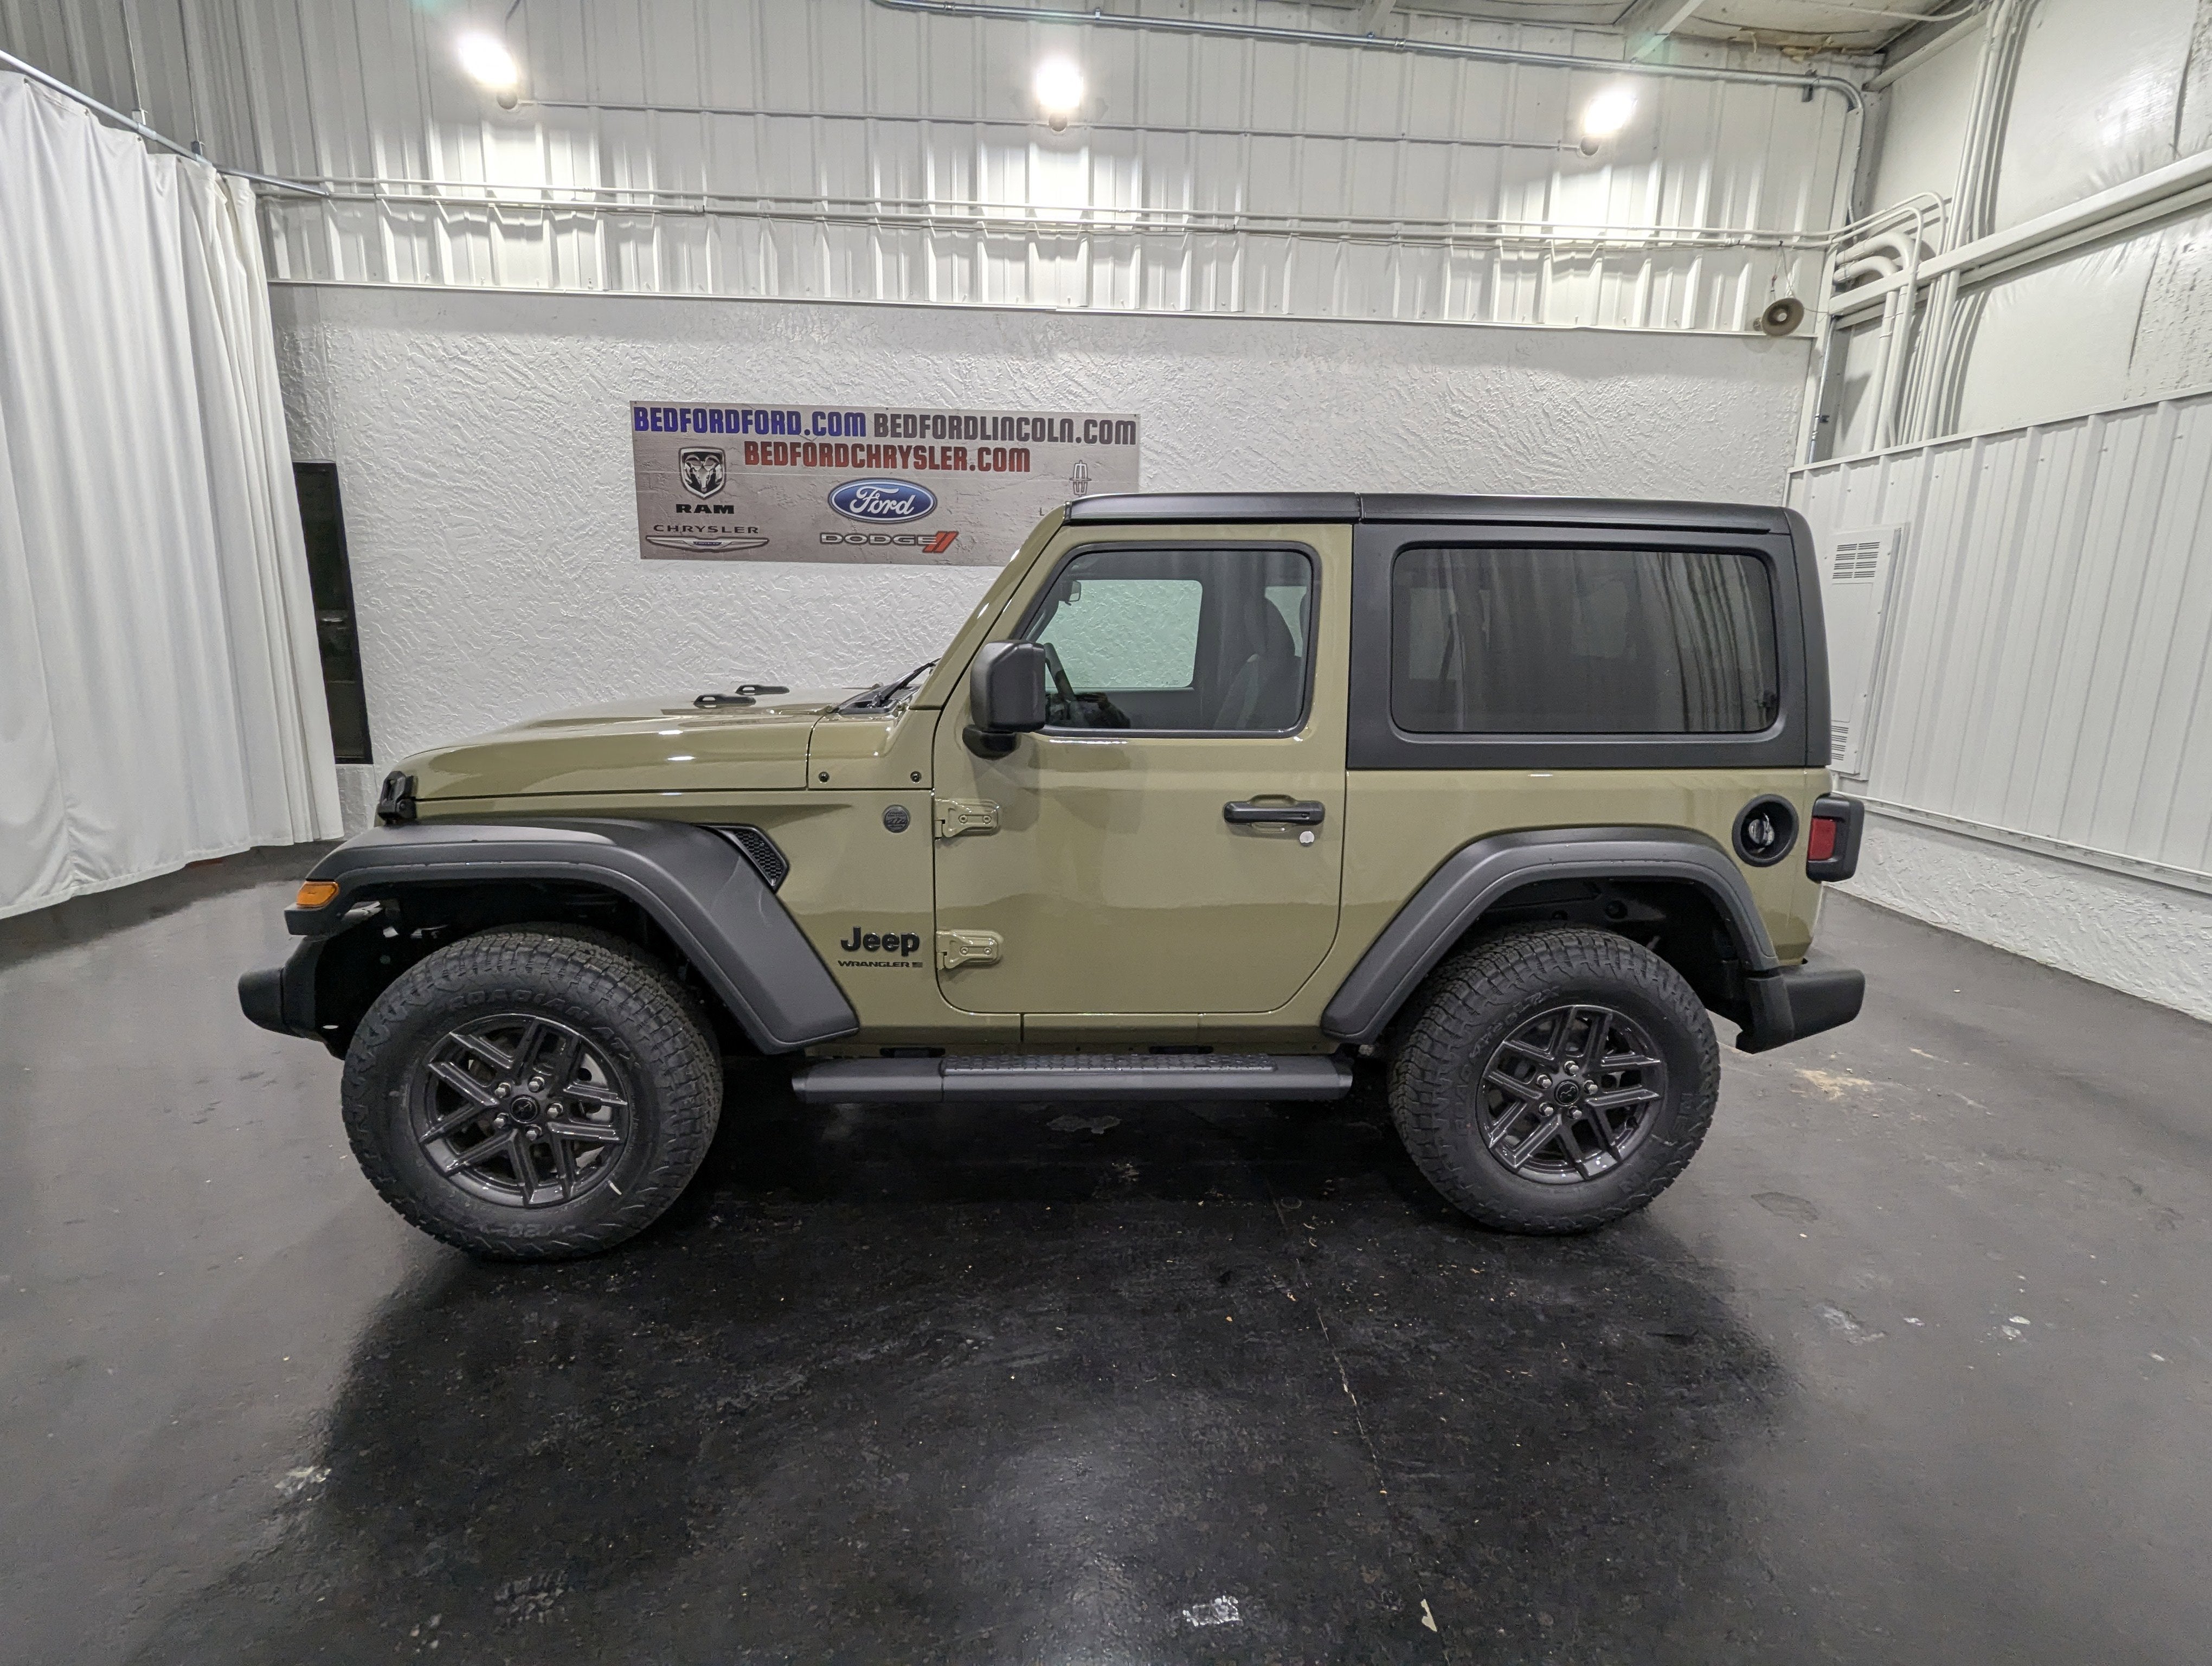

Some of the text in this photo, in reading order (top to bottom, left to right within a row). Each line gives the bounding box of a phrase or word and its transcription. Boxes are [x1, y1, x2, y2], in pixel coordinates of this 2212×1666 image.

[634, 407, 1136, 445] BEDFORDFORD.COM BEDFORDLINCOLN.COM
[744, 441, 1030, 472] BEDFORDCHRYSLER.COM
[676, 504, 734, 514] RAM
[850, 486, 915, 515] Ford
[653, 524, 758, 534] CHRYSLER
[820, 531, 937, 545] DODGE
[840, 926, 919, 956] Jeep
